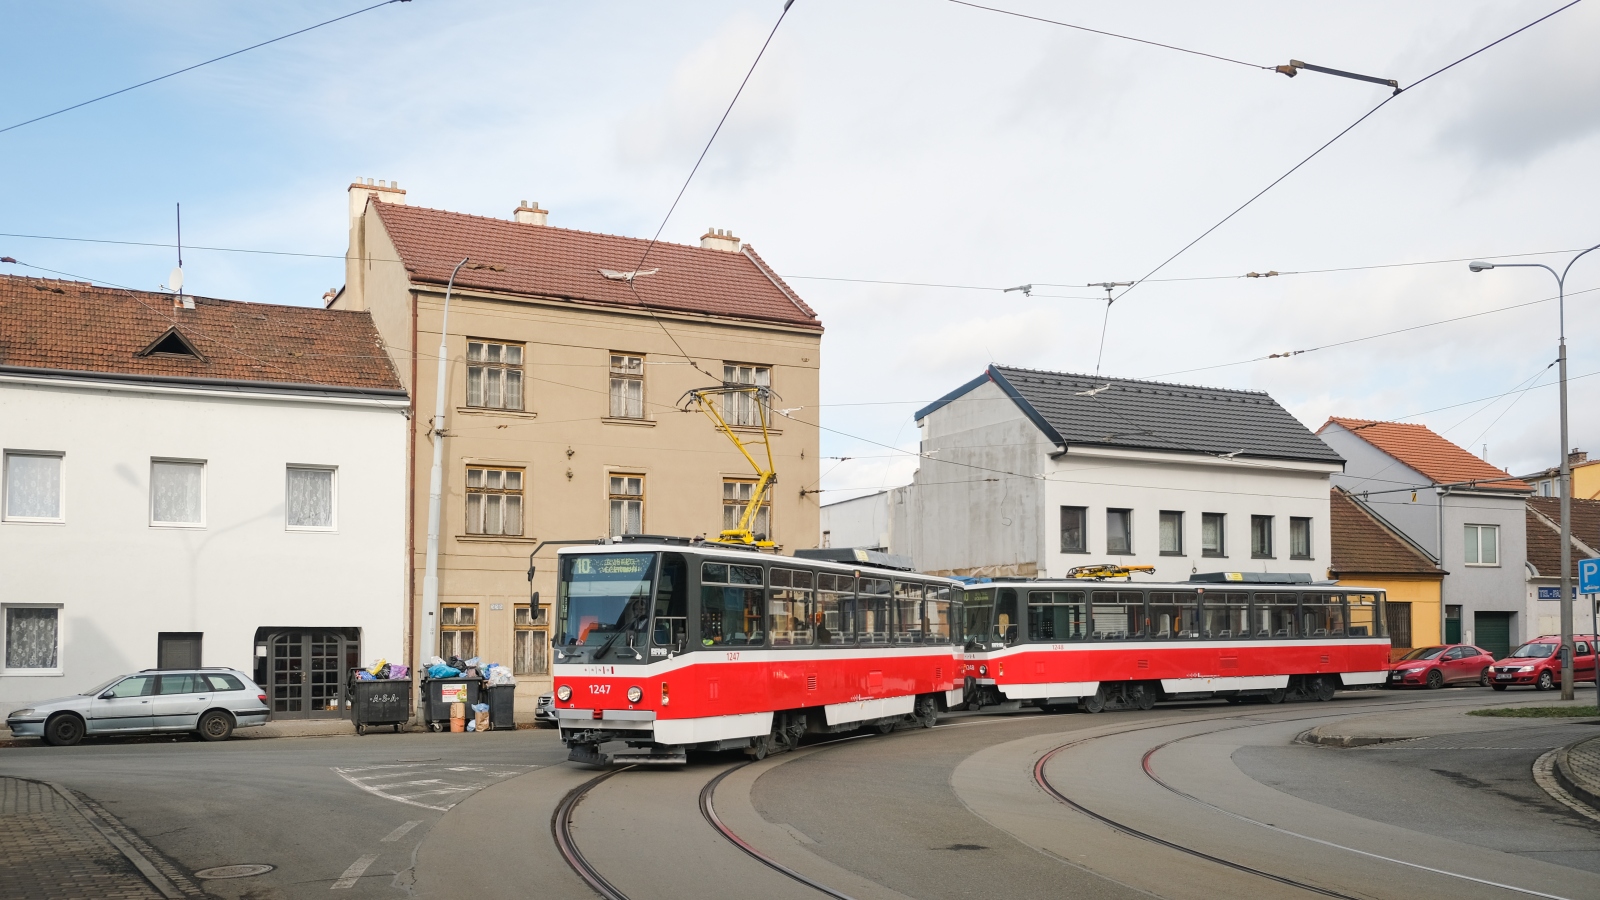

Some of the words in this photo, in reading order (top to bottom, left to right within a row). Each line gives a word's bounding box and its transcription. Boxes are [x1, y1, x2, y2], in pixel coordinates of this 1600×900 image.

[576, 558, 591, 574] 10
[1583, 562, 1598, 583] P
[726, 652, 740, 661] 1247
[588, 684, 611, 694] 1247
